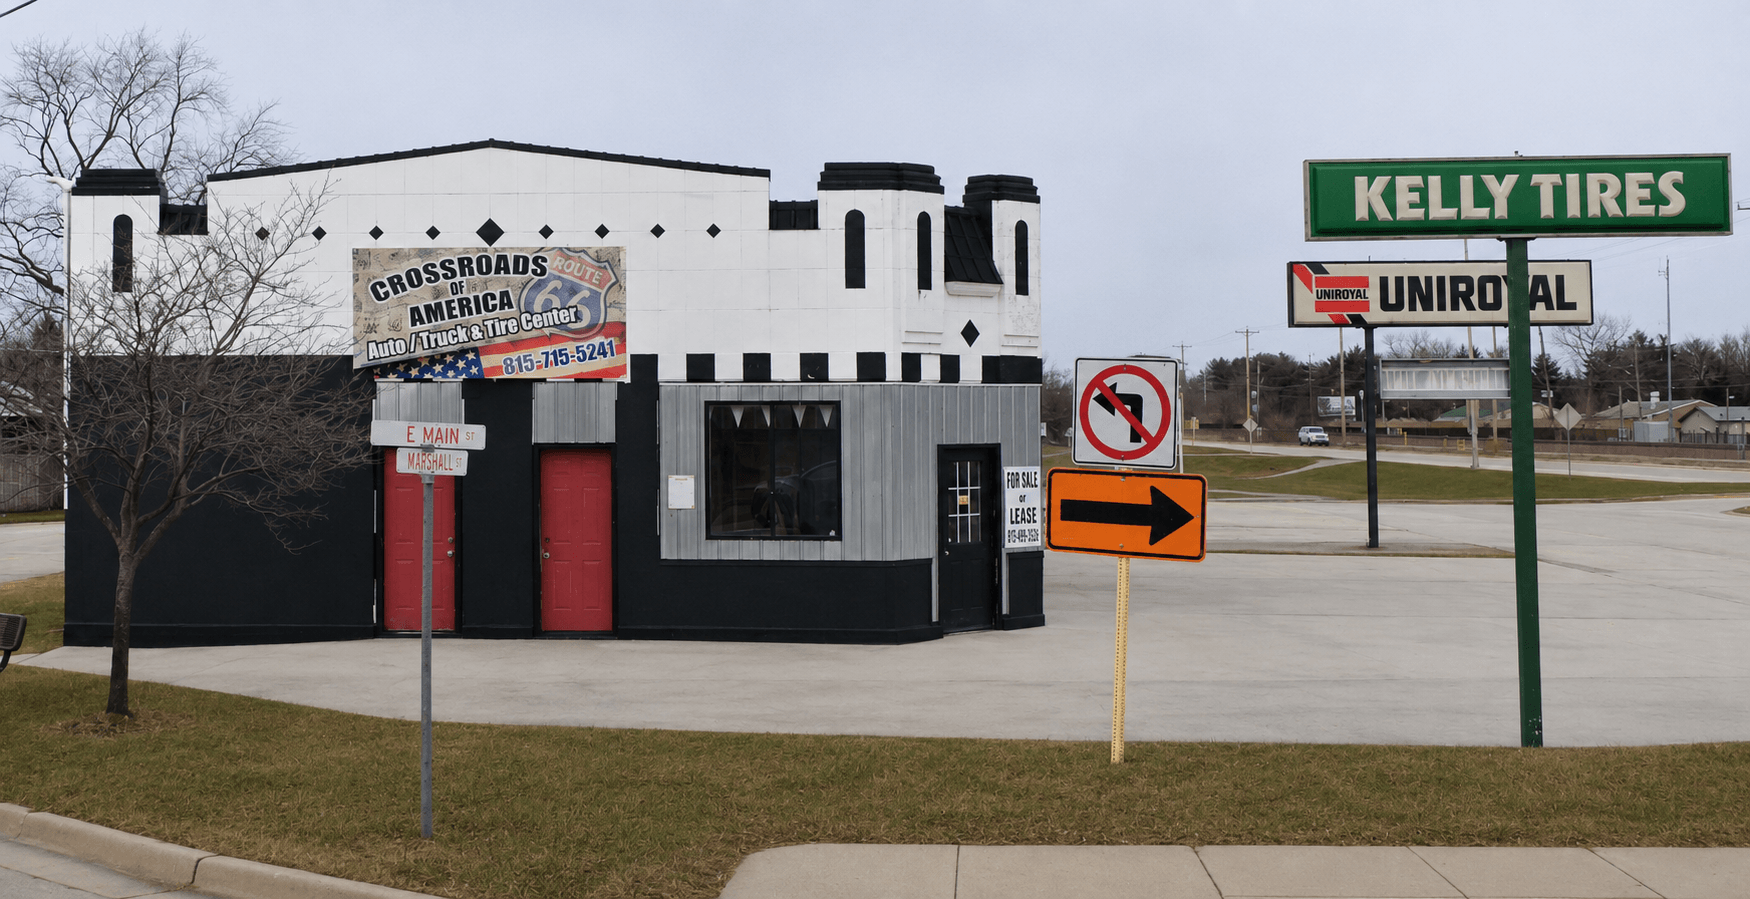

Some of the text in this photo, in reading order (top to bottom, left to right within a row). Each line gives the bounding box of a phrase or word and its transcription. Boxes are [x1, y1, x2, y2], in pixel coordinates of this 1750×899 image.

[1354, 170, 1687, 222] KELLY TIRES
[369, 254, 548, 302] CROSSROADS
[552, 256, 603, 285] ROUTE
[449, 280, 465, 296] OF
[1315, 288, 1370, 300] UNIROYAL
[1379, 274, 1577, 312] UNIROAL
[409, 290, 514, 328] AMERICA
[533, 279, 591, 329] 66
[367, 338, 408, 360] Auto
[418, 324, 470, 350] Truck
[470, 323, 485, 341] &
[483, 317, 519, 338] Tire
[520, 305, 579, 332] Center
[502, 340, 616, 375] 815-715-5241
[407, 426, 475, 445] E MAIN ST
[408, 452, 453, 471] MARSHALL
[1007, 471, 1038, 489] FOR SALE
[1019, 495, 1026, 503] or
[1010, 507, 1037, 525] LEASE
